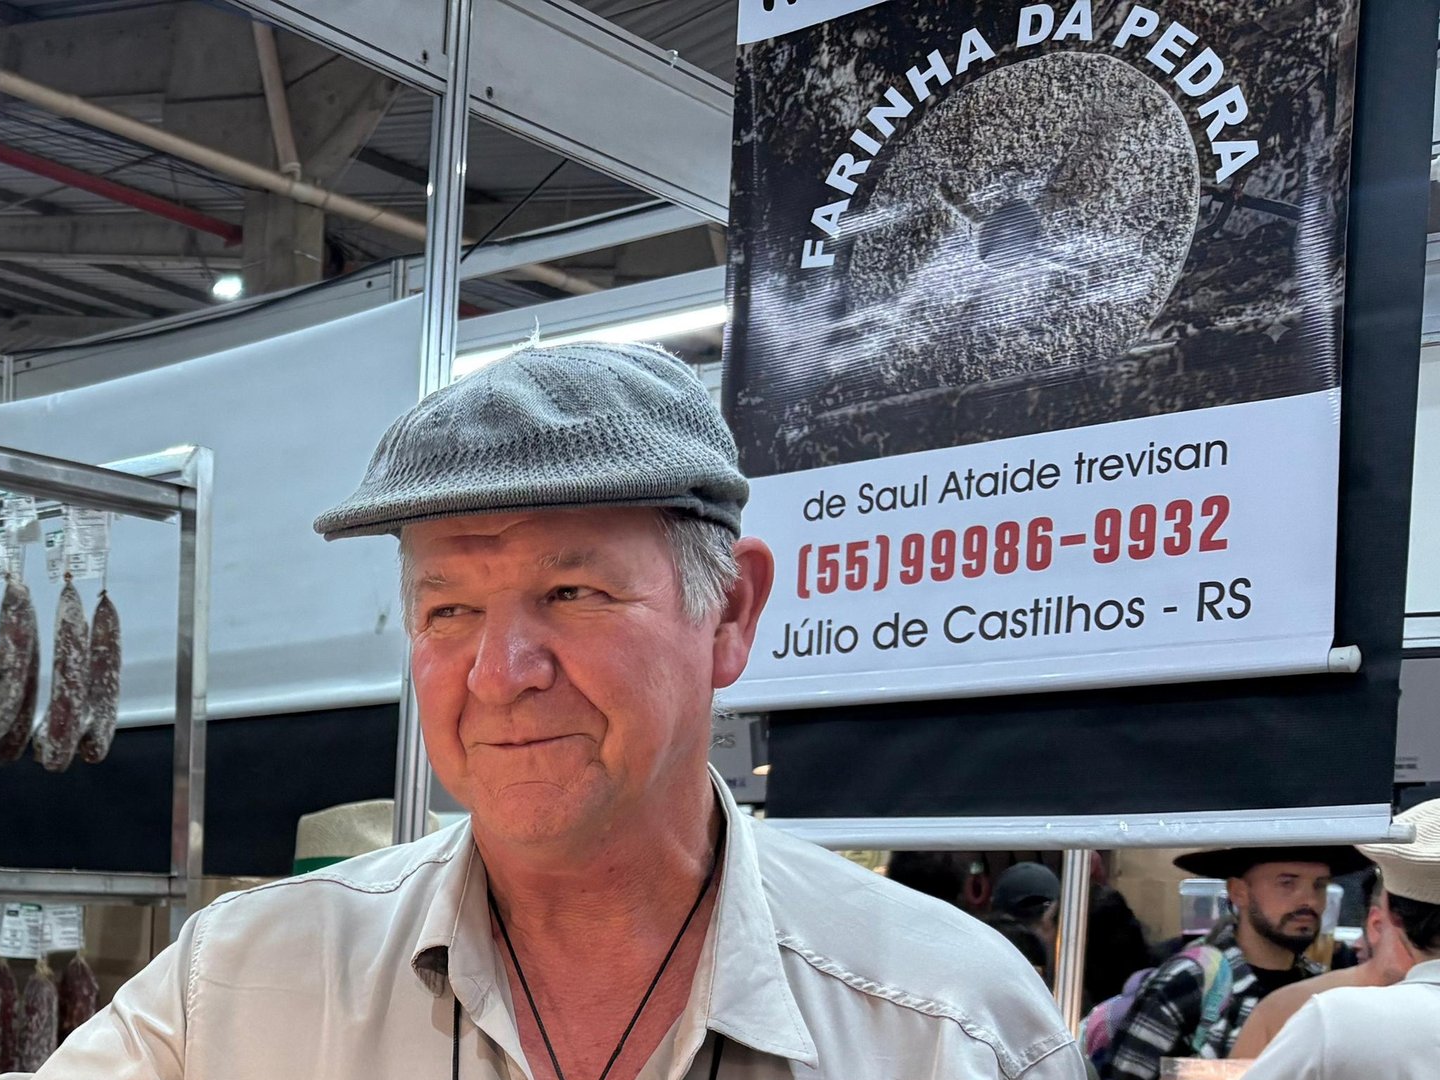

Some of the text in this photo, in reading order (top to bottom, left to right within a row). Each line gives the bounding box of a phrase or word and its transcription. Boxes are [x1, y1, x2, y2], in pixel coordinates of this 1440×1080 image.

[801, 0, 1259, 269] FARINHA DA PEDRA
[803, 439, 1229, 521] de Saul Ataide trevisan
[797, 495, 1230, 599] (55)99986-9932
[772, 618, 859, 659] Júlio
[873, 612, 928, 650] de
[944, 595, 1145, 643] Castilhos
[1197, 577, 1252, 622] RS
